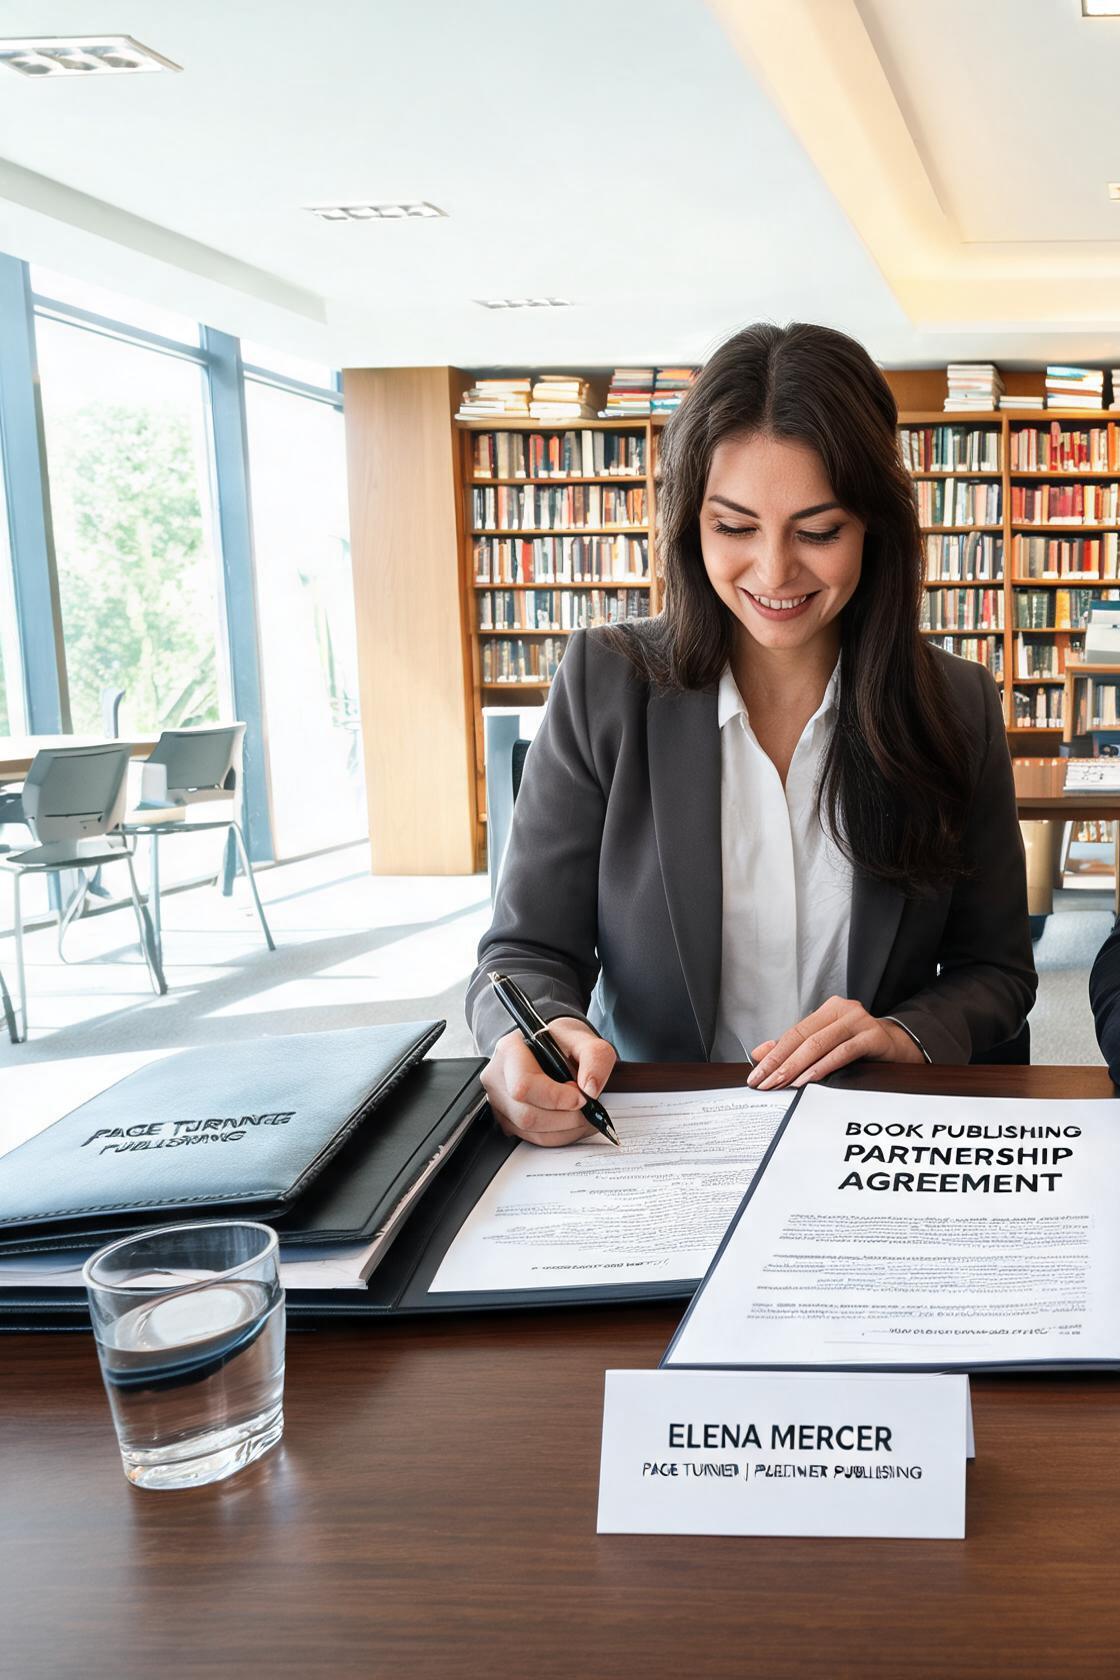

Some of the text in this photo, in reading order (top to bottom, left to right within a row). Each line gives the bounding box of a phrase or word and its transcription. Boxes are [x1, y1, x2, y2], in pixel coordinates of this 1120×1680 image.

[845, 1121, 1082, 1140] BOOK PUBLISHING
[843, 1144, 1074, 1167] PARTNERSHIP
[837, 1171, 1063, 1194] AGREEMENT
[668, 1423, 893, 1452] ELENA MERCER
